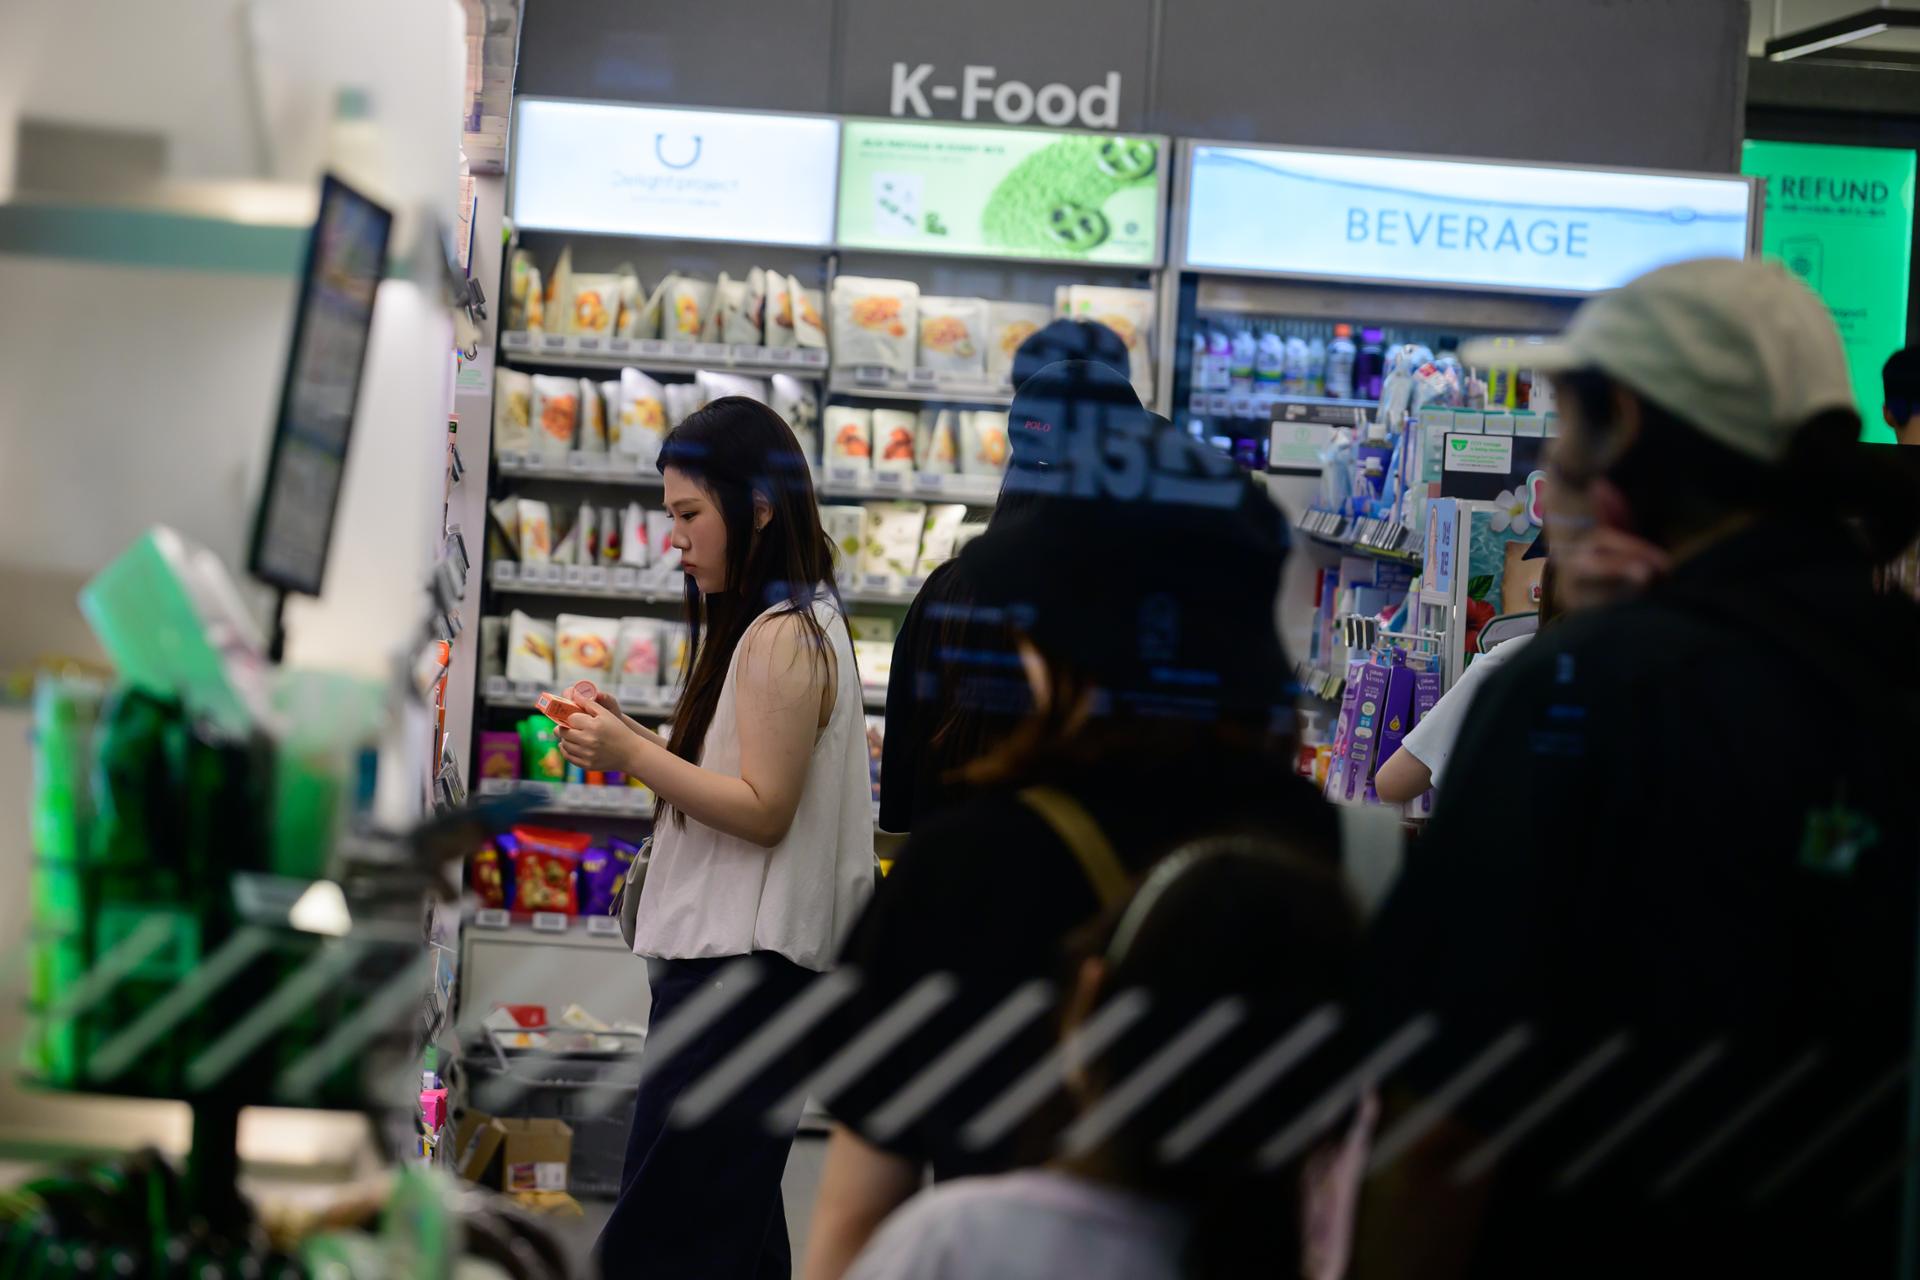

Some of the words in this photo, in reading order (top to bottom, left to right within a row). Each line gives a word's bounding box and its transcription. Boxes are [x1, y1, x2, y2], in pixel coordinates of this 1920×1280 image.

[891, 62, 1121, 129] K-Food
[1781, 175, 1889, 204] REFUND
[1346, 207, 1589, 259] BEVERAGE
[1024, 420, 1051, 432] POLO
